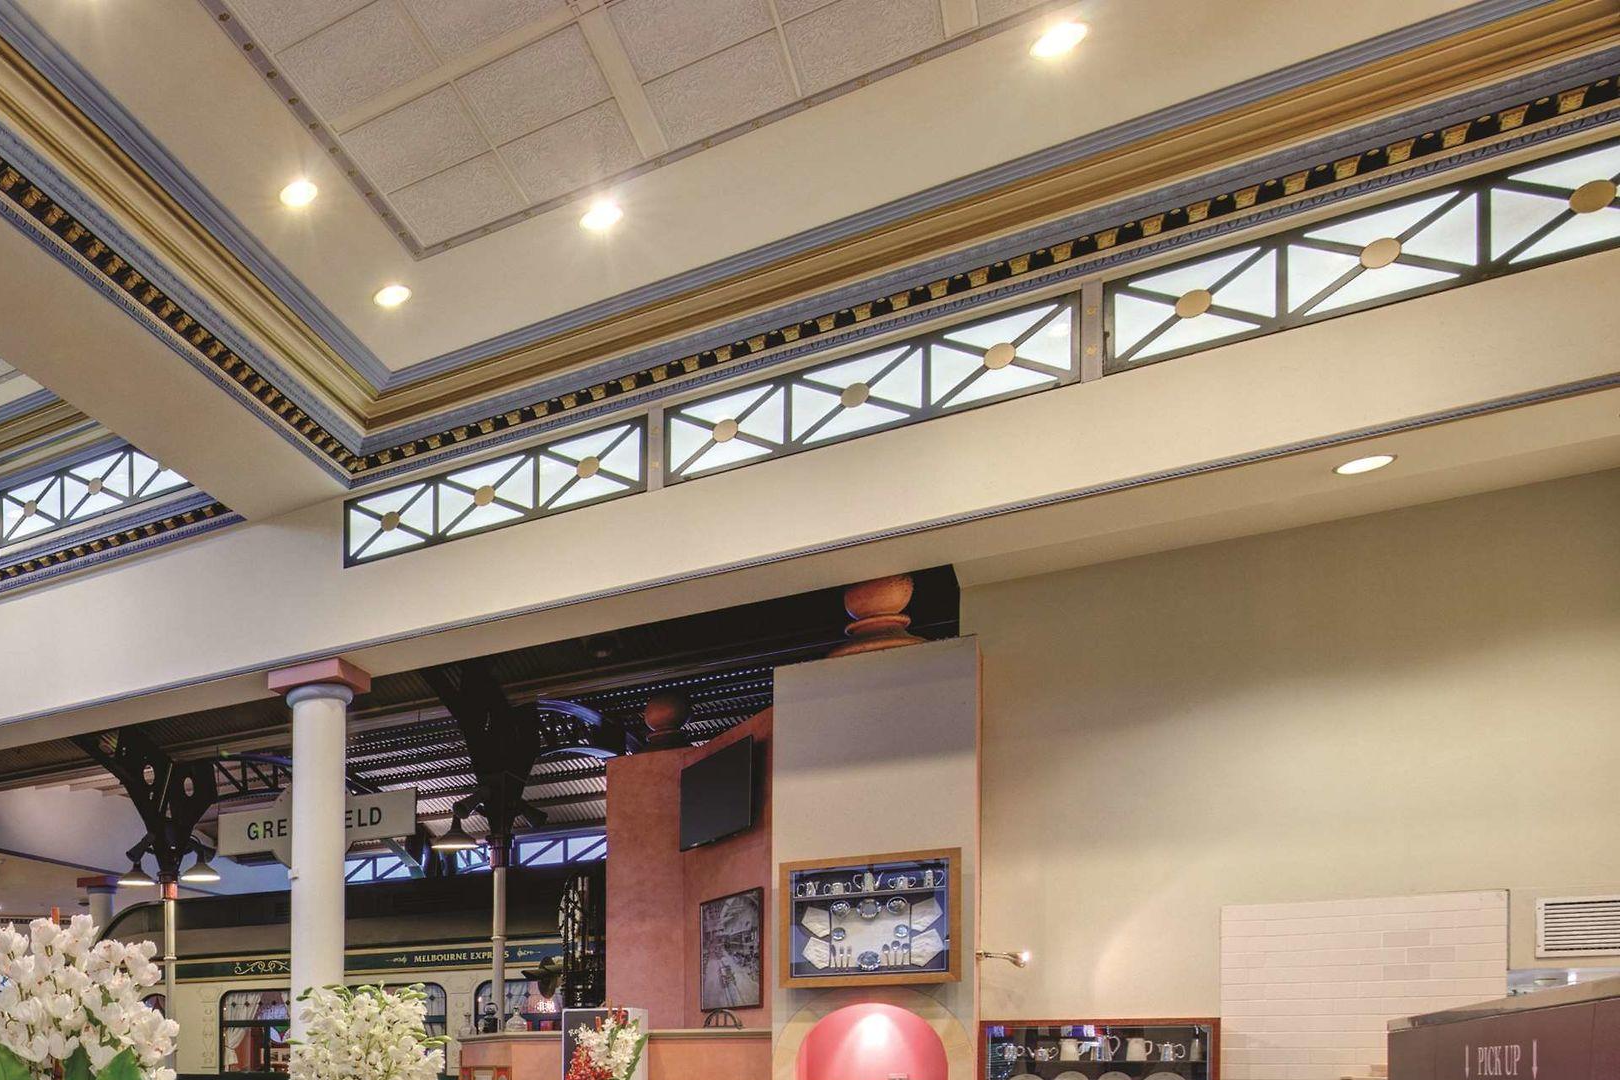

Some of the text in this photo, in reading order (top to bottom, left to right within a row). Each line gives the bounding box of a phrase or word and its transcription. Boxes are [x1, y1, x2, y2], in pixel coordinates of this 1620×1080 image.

[247, 806, 382, 841] GREELD
[414, 950, 509, 963] MELBOURNE EXPRS
[1477, 1044, 1521, 1076] PICK UP
